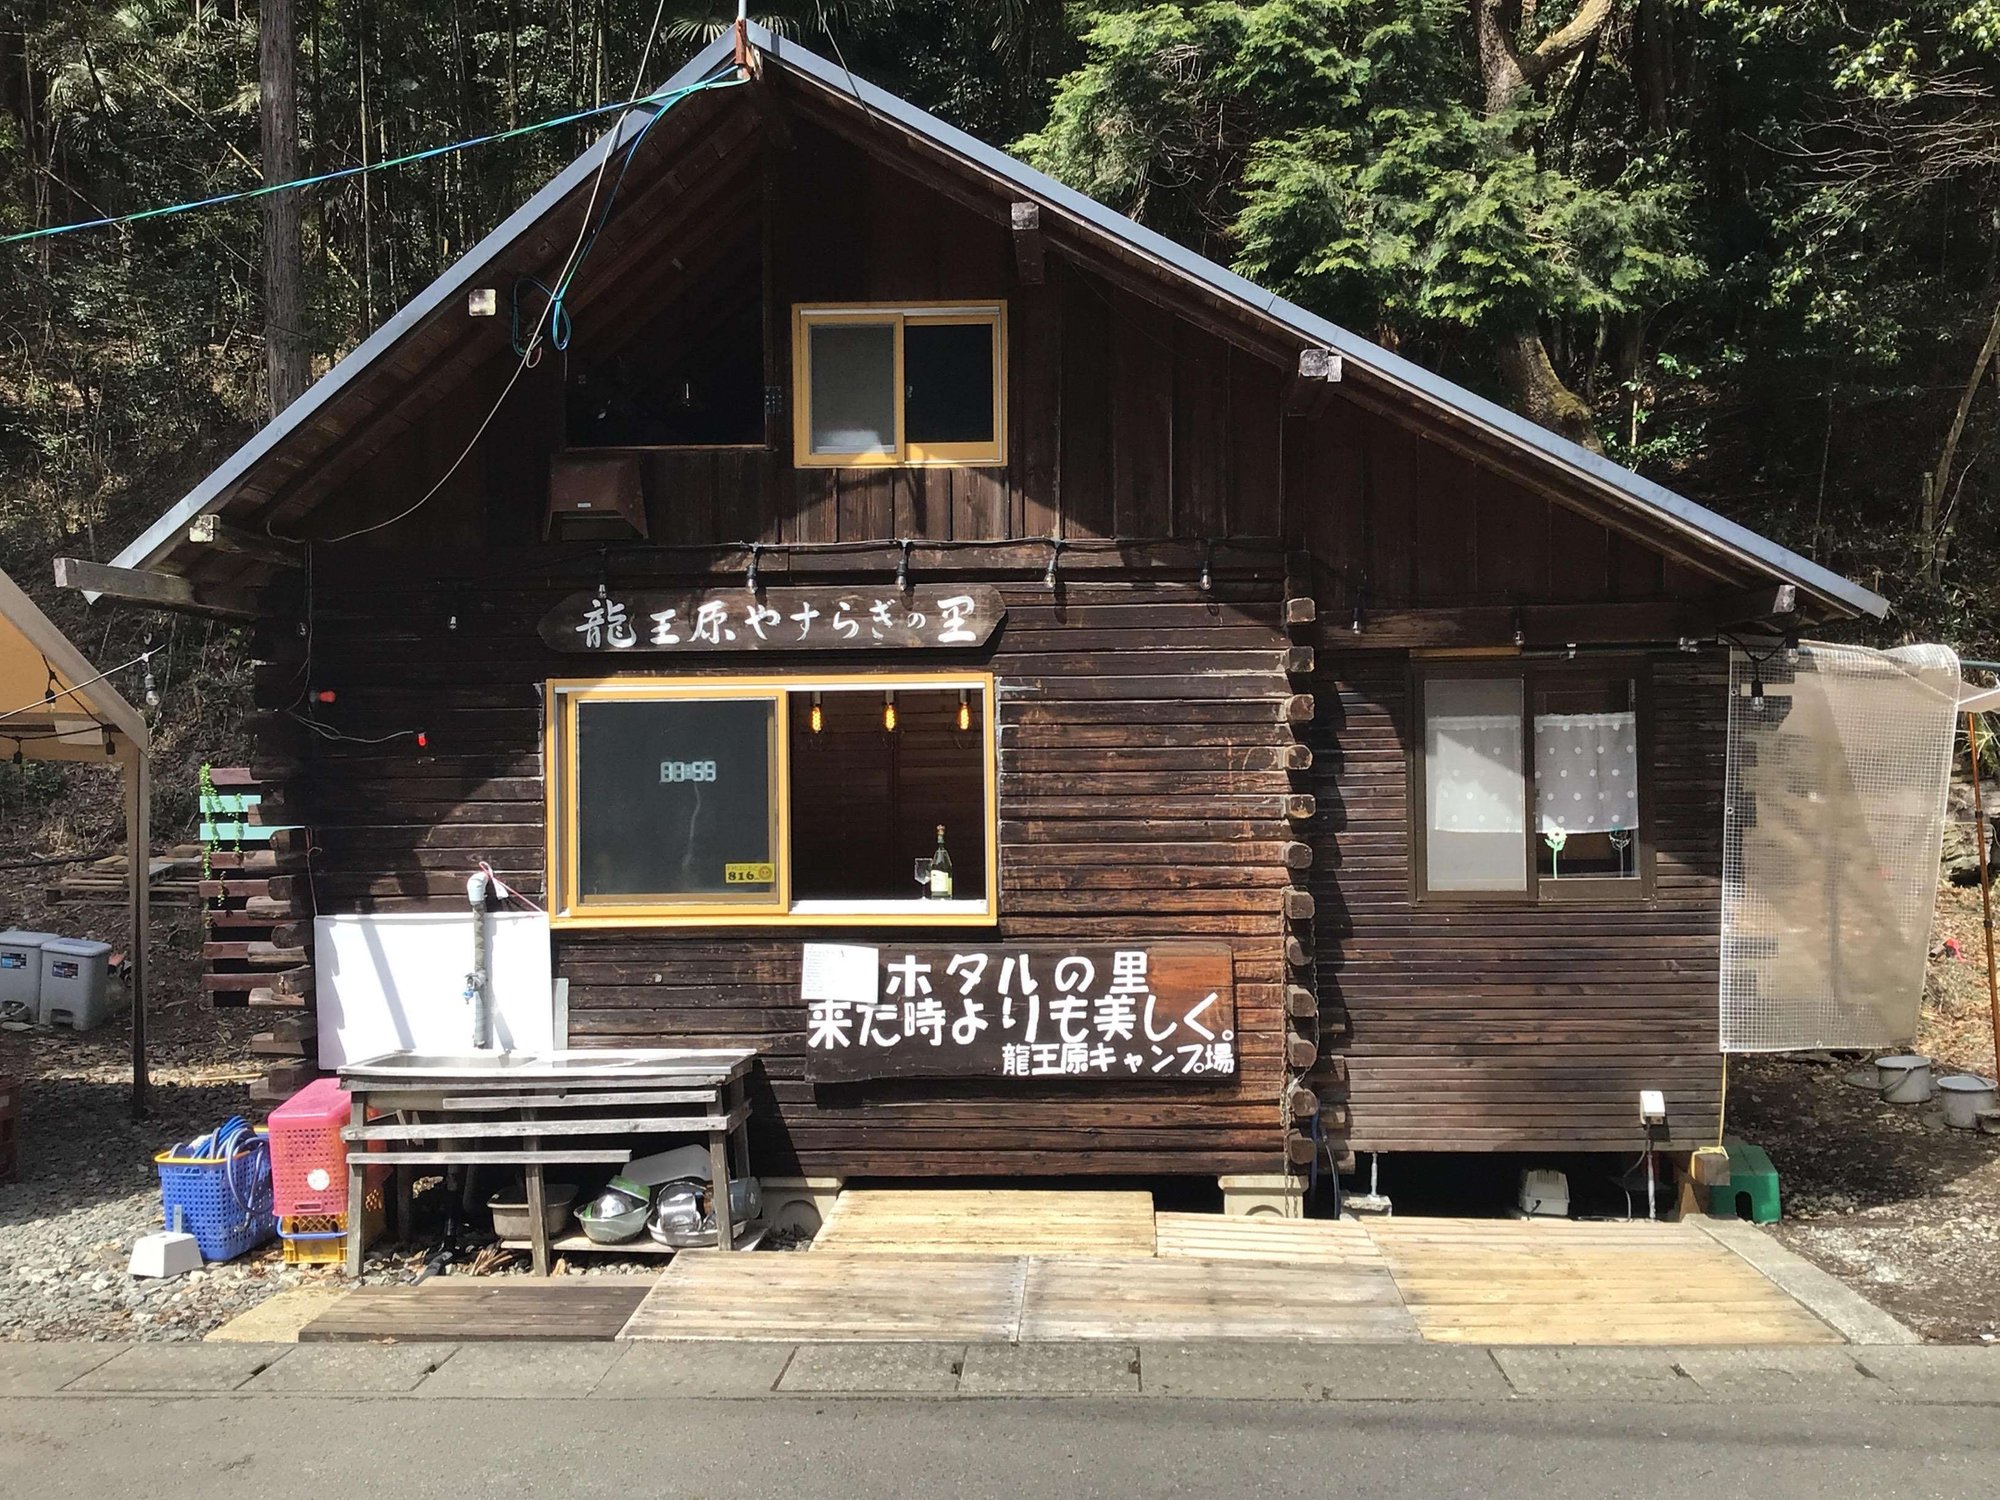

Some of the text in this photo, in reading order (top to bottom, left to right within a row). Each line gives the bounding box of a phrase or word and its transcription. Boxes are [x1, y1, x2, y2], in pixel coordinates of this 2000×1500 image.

[575, 595, 977, 648] 龍王原やすらぎの里
[886, 951, 1150, 996] ホタルの里
[808, 992, 1234, 1049] 来た時よりも美しく。
[1002, 1043, 1235, 1076] 龍王原キャンプ場
